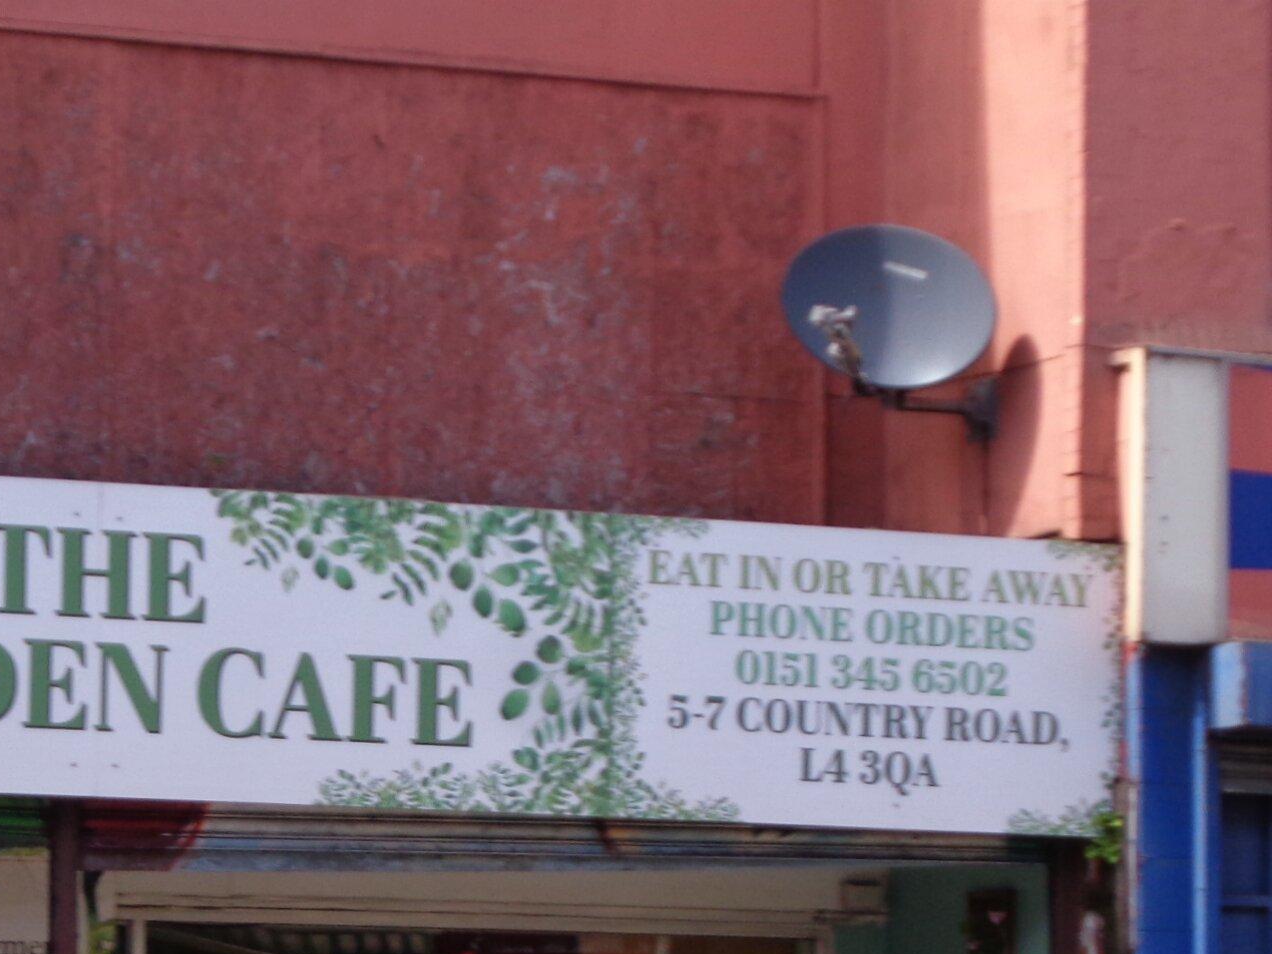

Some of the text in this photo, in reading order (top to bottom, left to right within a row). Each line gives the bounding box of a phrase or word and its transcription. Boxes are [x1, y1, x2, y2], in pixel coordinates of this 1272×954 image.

[647, 549, 1093, 609] EAT IN OR TAKE AWAY
[709, 600, 1035, 652] PHONE ORDERS
[197, 647, 473, 748] CAFE
[734, 649, 1008, 698] 0151 345 6502
[667, 694, 1070, 752] 5-7 COUNTRY ROAD,
[799, 747, 940, 797] L4 3QA
